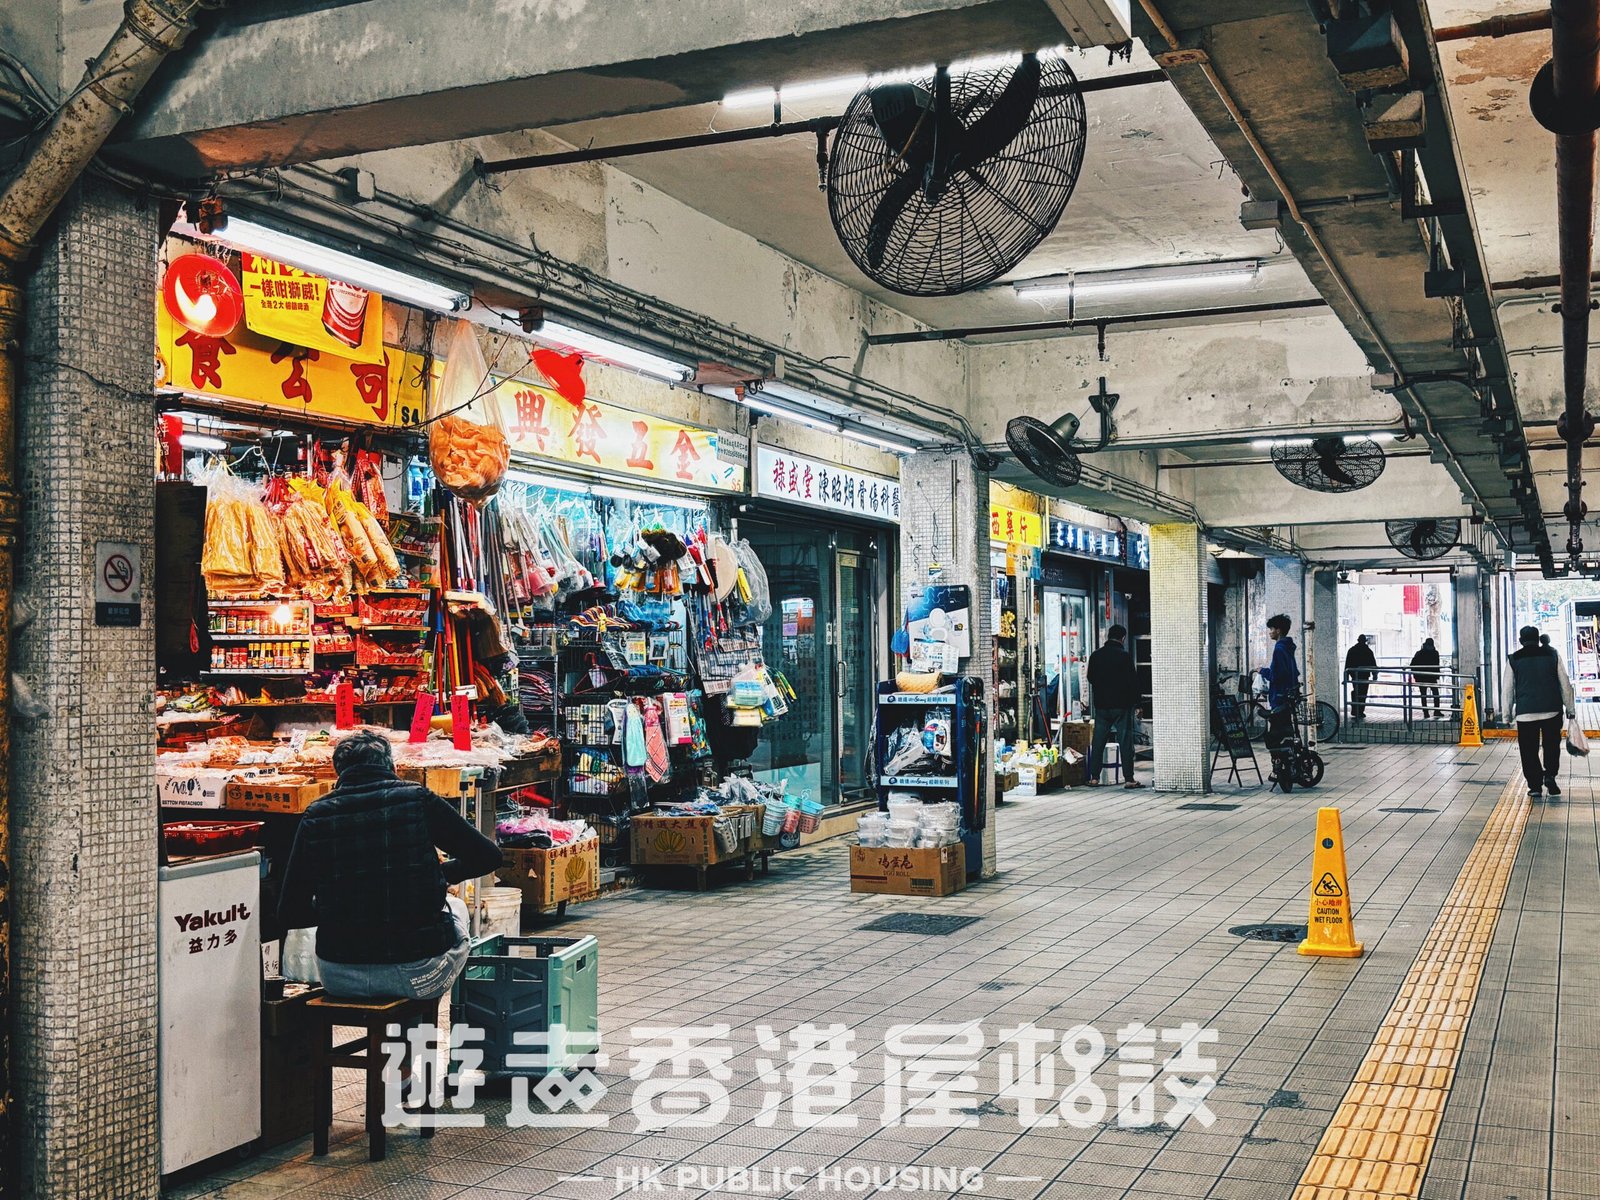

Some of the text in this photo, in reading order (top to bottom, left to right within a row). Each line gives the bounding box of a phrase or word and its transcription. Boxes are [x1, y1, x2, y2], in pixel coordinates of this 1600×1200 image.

[401, 406, 418, 425] S4
[509, 389, 701, 479] 興發五金
[731, 478, 742, 492] S5
[174, 903, 251, 932] Yakult
[1316, 907, 1340, 915] CAUTION
[1326, 916, 1343, 924] FLOOR
[189, 929, 237, 954] 益力多
